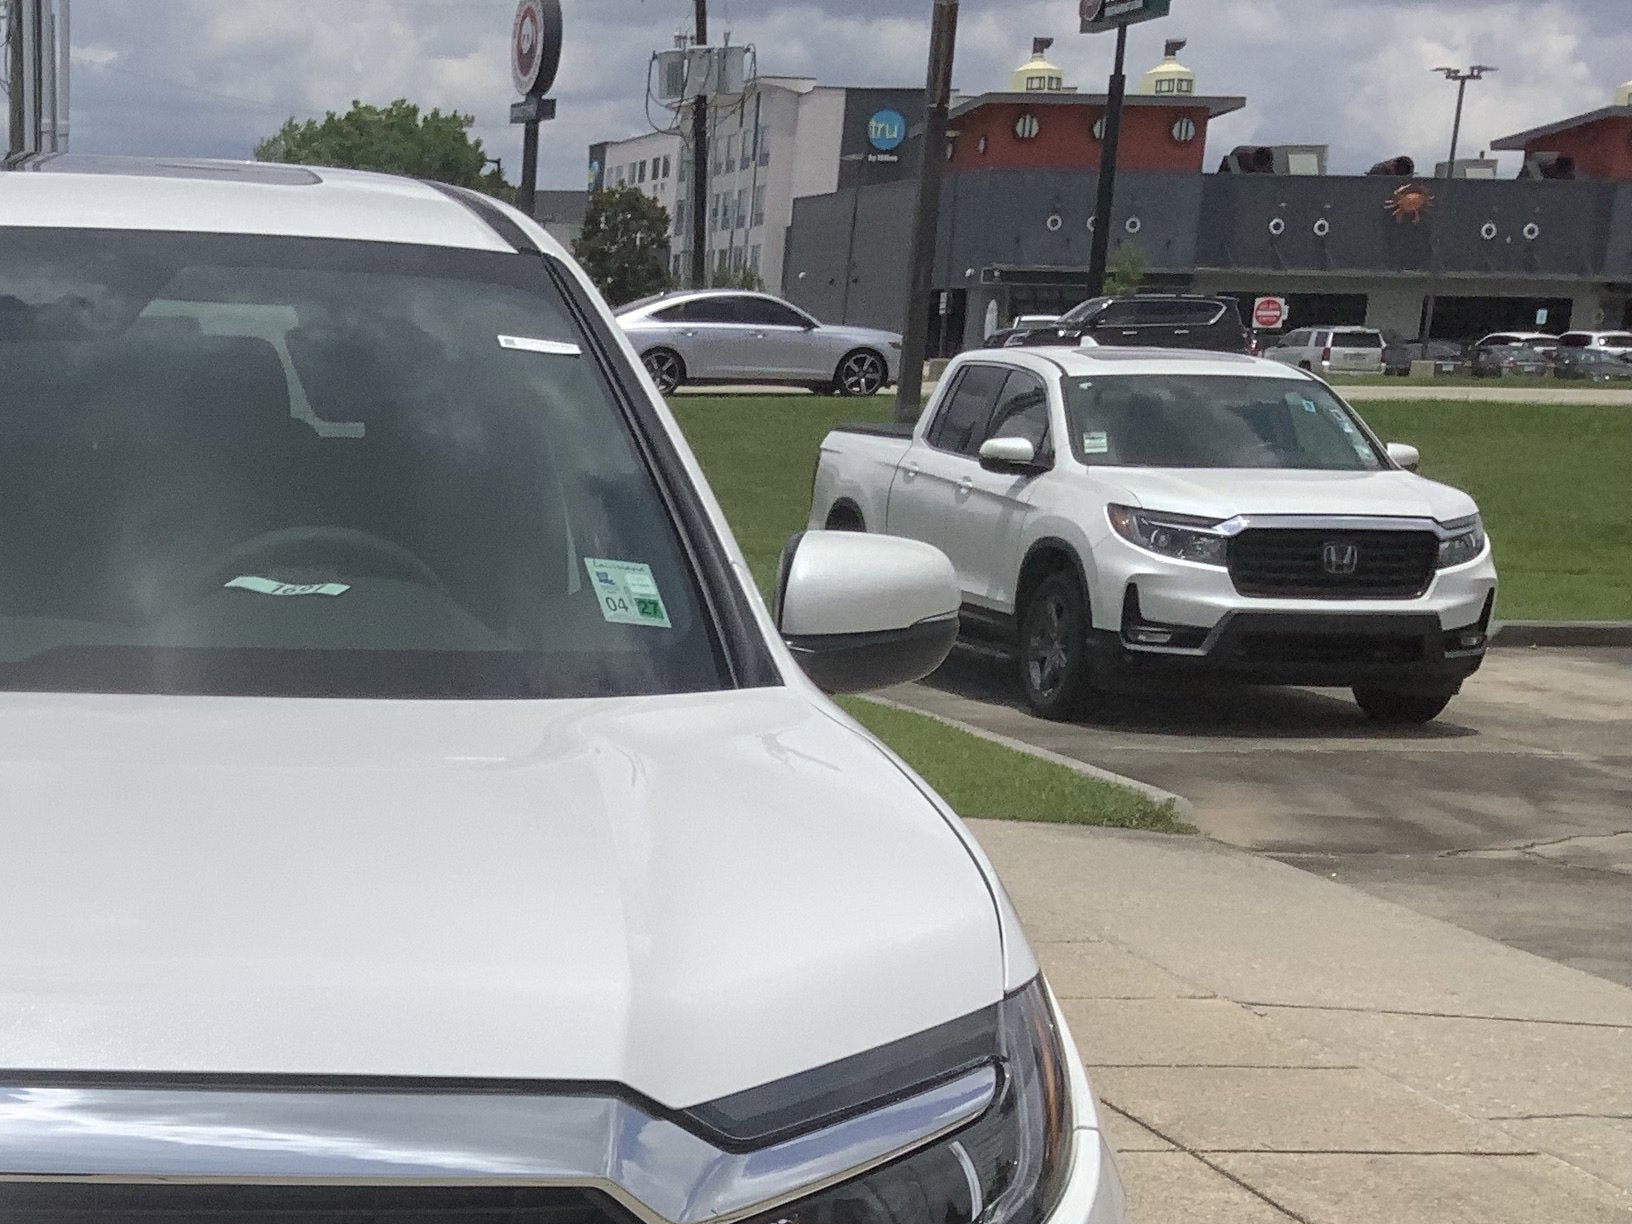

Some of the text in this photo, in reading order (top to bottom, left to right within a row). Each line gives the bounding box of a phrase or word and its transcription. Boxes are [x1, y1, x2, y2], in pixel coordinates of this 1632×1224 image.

[869, 118, 898, 139] tru
[605, 597, 659, 616] 04 27
